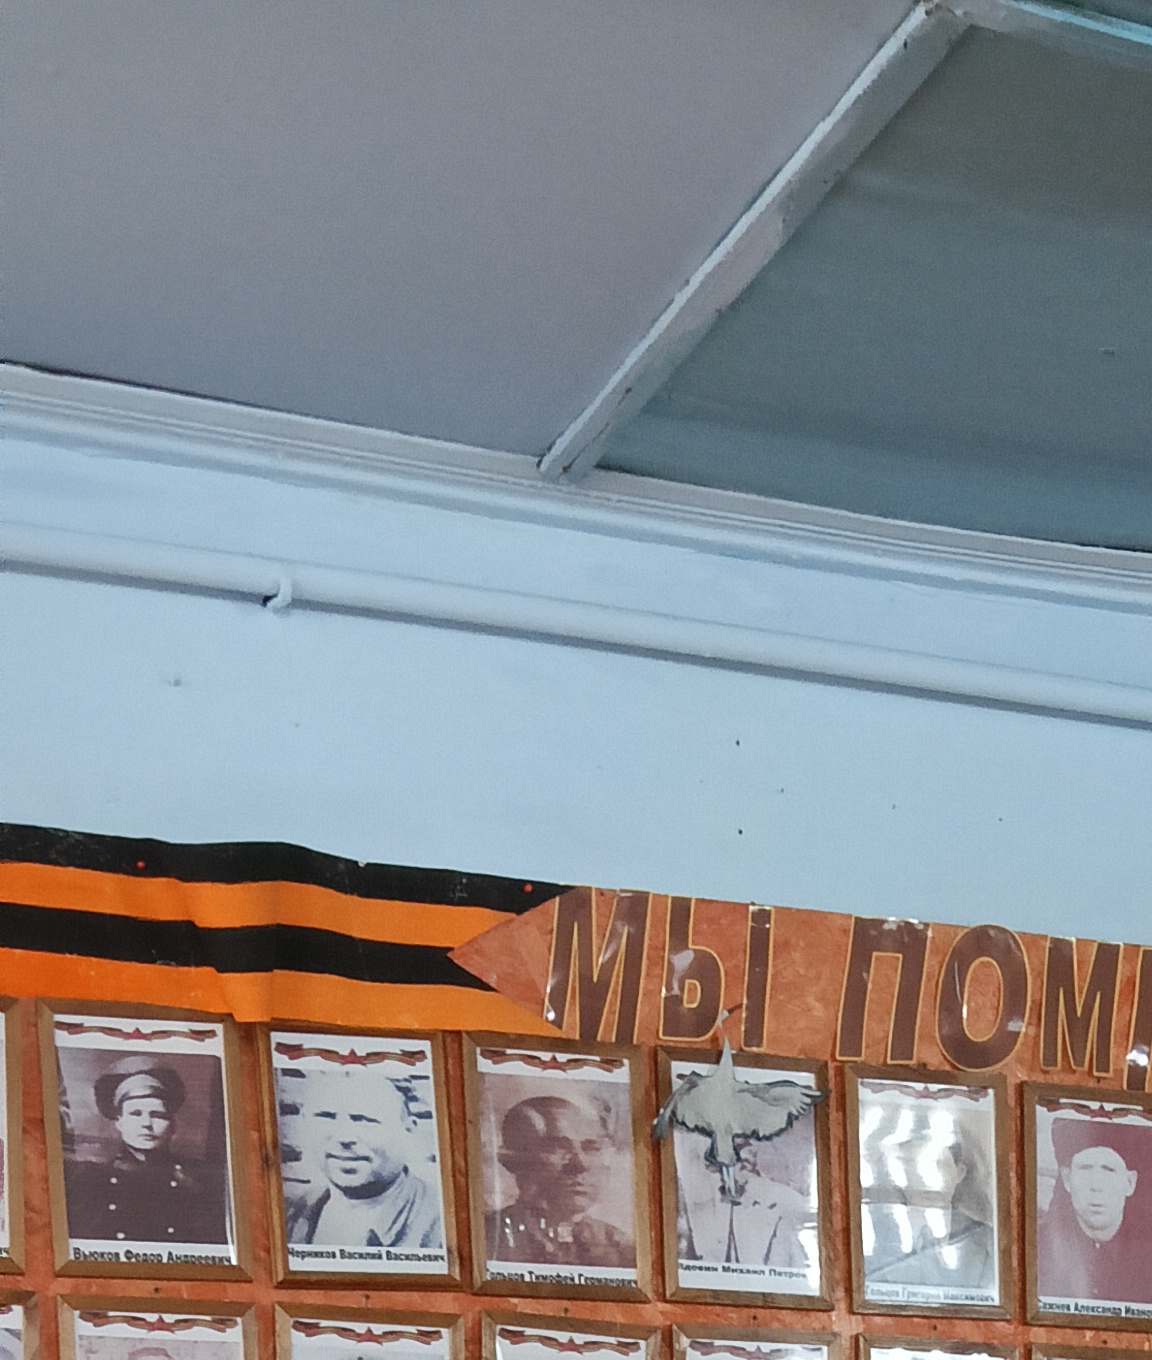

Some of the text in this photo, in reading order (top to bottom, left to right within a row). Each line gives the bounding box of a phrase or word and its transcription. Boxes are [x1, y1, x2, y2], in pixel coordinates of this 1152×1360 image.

[546, 886, 774, 1050] МЫ
[339, 1248, 383, 1260] Василий
[385, 1250, 446, 1262] Васильевич
[721, 1265, 765, 1276] Михаил
[1073, 1302, 1122, 1316] Александр
